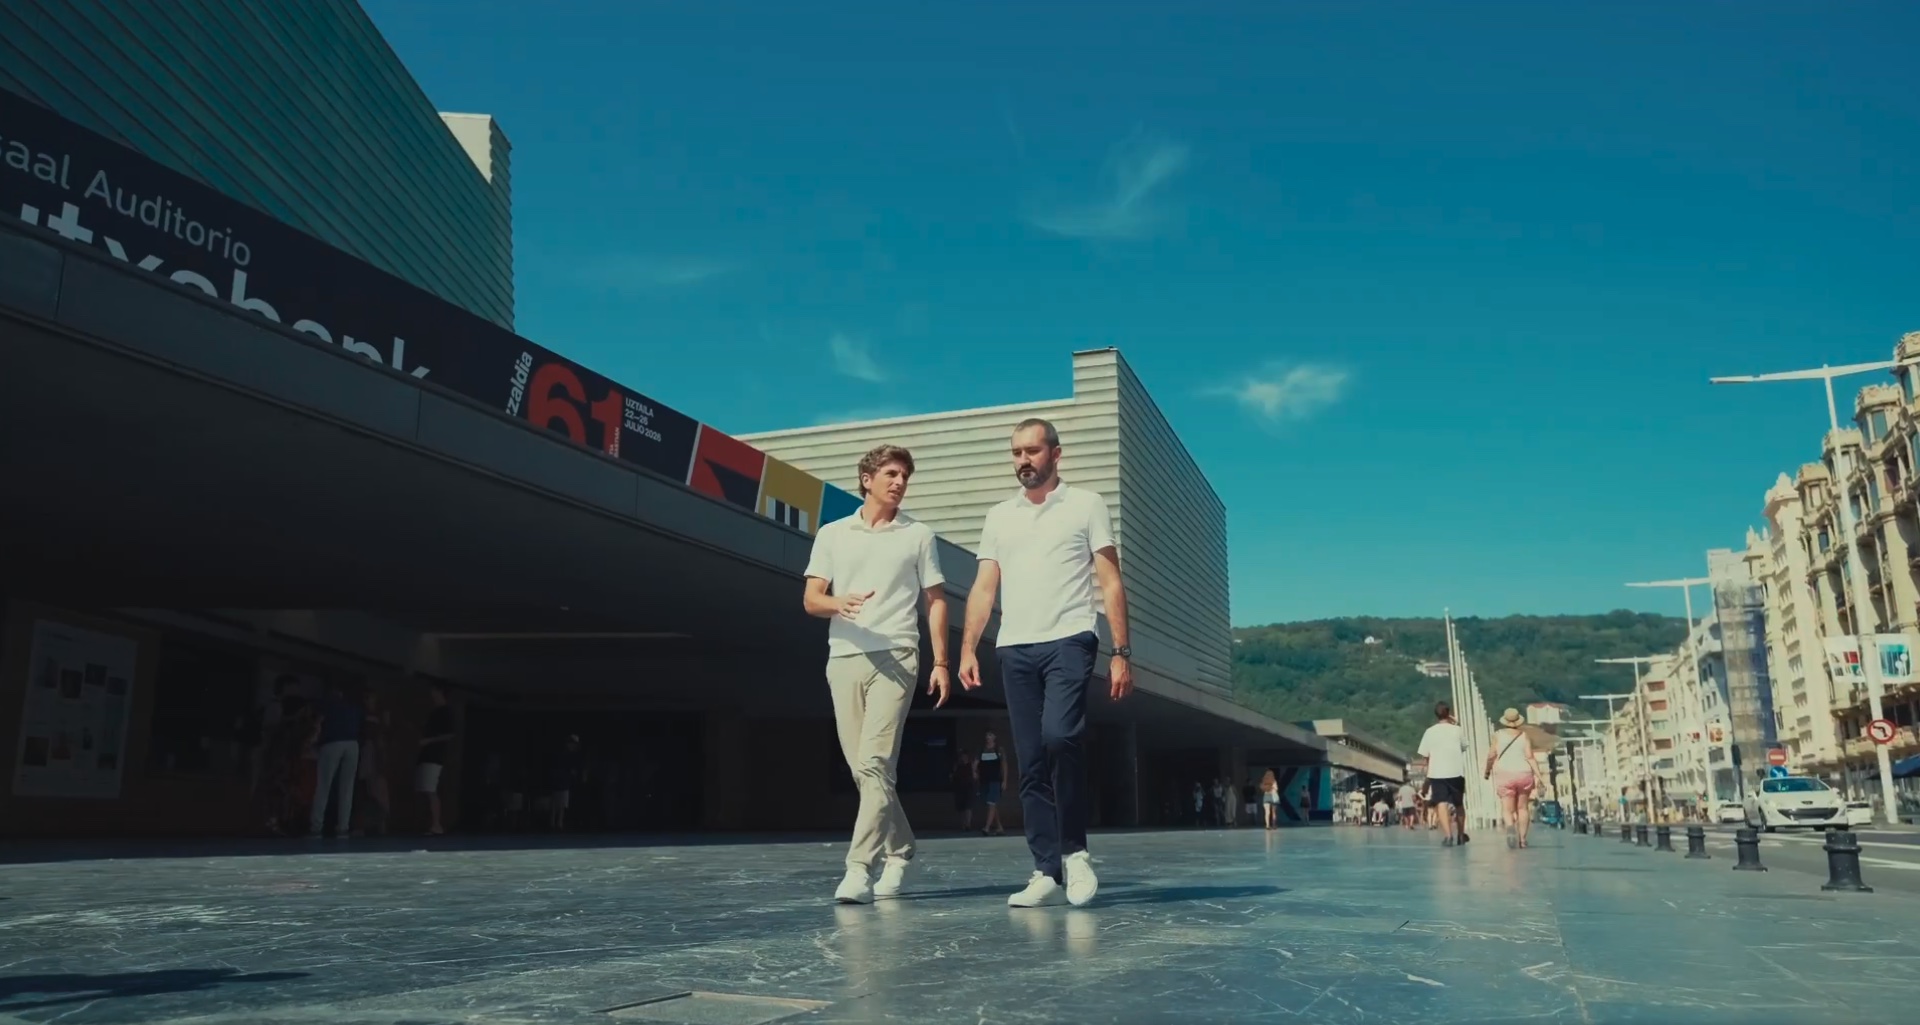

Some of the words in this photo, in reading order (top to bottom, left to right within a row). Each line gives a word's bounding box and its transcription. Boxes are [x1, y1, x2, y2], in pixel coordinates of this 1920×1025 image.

[0, 136, 71, 190] aal
[84, 169, 251, 266] Auditorio
[505, 351, 534, 417] zaldia
[528, 363, 624, 456] 61
[625, 397, 654, 418] UZTAILA
[624, 419, 645, 435] JULIO
